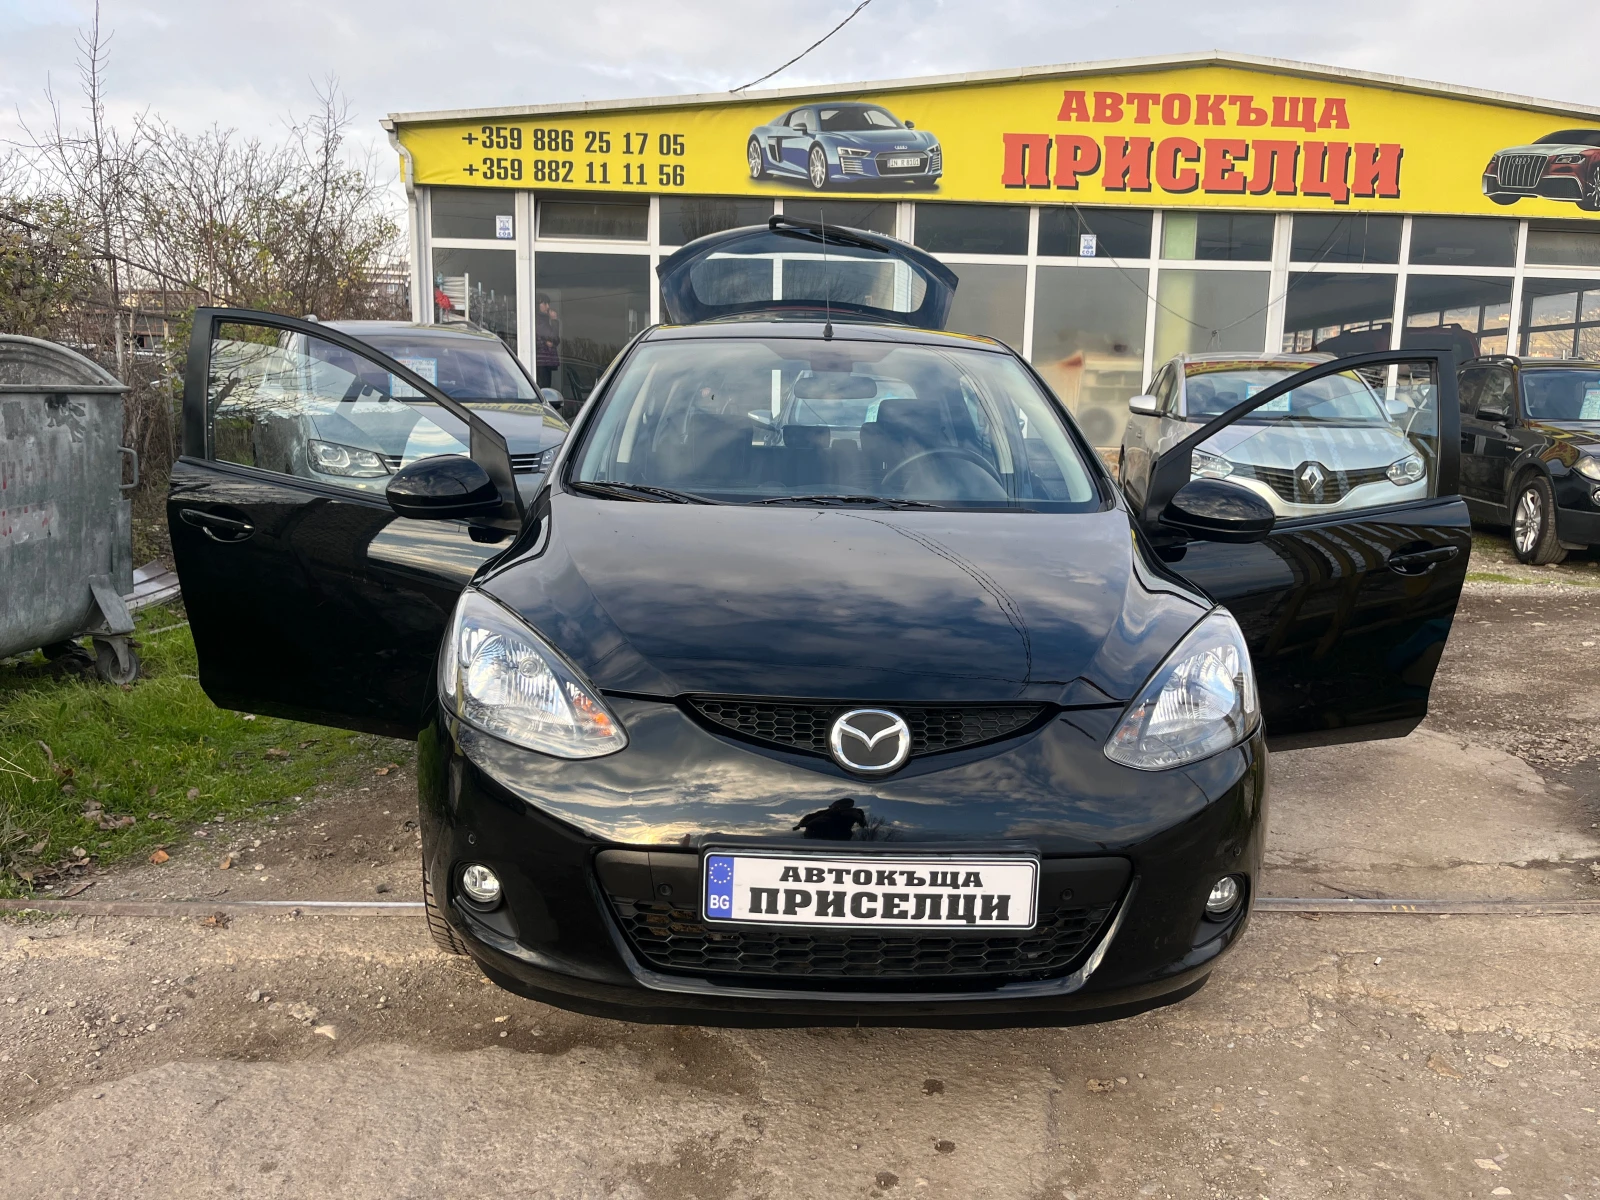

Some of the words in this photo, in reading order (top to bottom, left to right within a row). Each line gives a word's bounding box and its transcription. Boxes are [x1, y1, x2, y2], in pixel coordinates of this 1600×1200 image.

[1057, 91, 1350, 132] АВТОКЪЩА
[462, 126, 522, 150] +359
[533, 128, 574, 152] 886
[585, 131, 611, 154] 25
[622, 132, 649, 155] 17
[659, 133, 685, 156] 05
[462, 157, 523, 181] +359
[533, 159, 574, 183] 882
[585, 161, 611, 184] 11
[622, 163, 648, 185] 11
[658, 164, 685, 186] 56
[1001, 133, 1404, 204] ПРИСЕЛЦИ
[779, 866, 983, 889] АВТОКЪЩА
[709, 894, 730, 910] BG
[749, 887, 1011, 924] ПРИСЕЛЦИ
